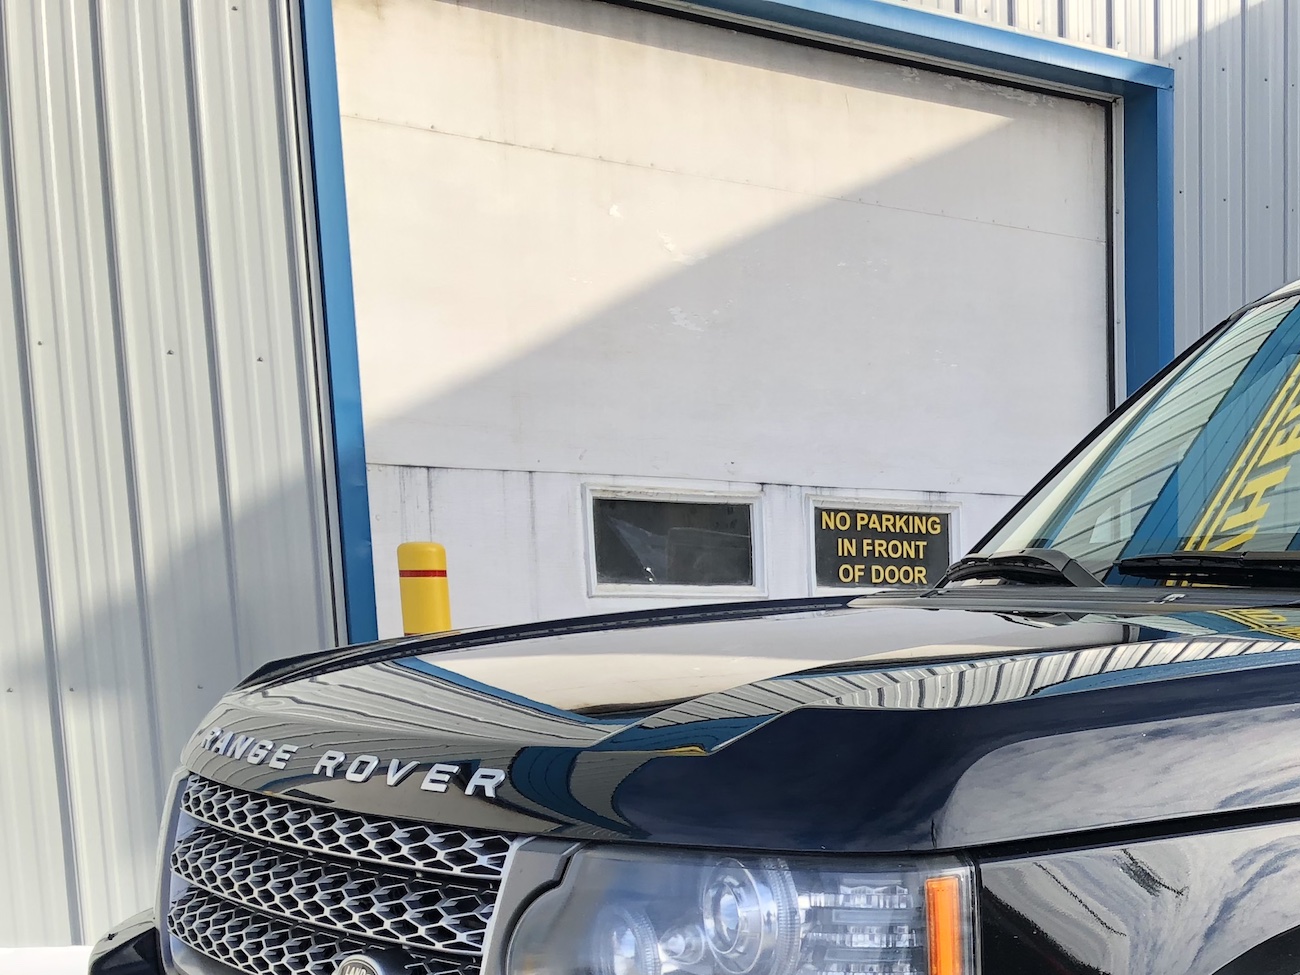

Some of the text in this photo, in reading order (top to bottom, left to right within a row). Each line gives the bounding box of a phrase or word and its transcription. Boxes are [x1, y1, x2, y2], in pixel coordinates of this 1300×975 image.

[821, 511, 941, 535] NO PARKING
[837, 537, 927, 559] IN FRONT
[838, 564, 927, 585] OF DOOR
[200, 726, 507, 799] RANGE ROVER
